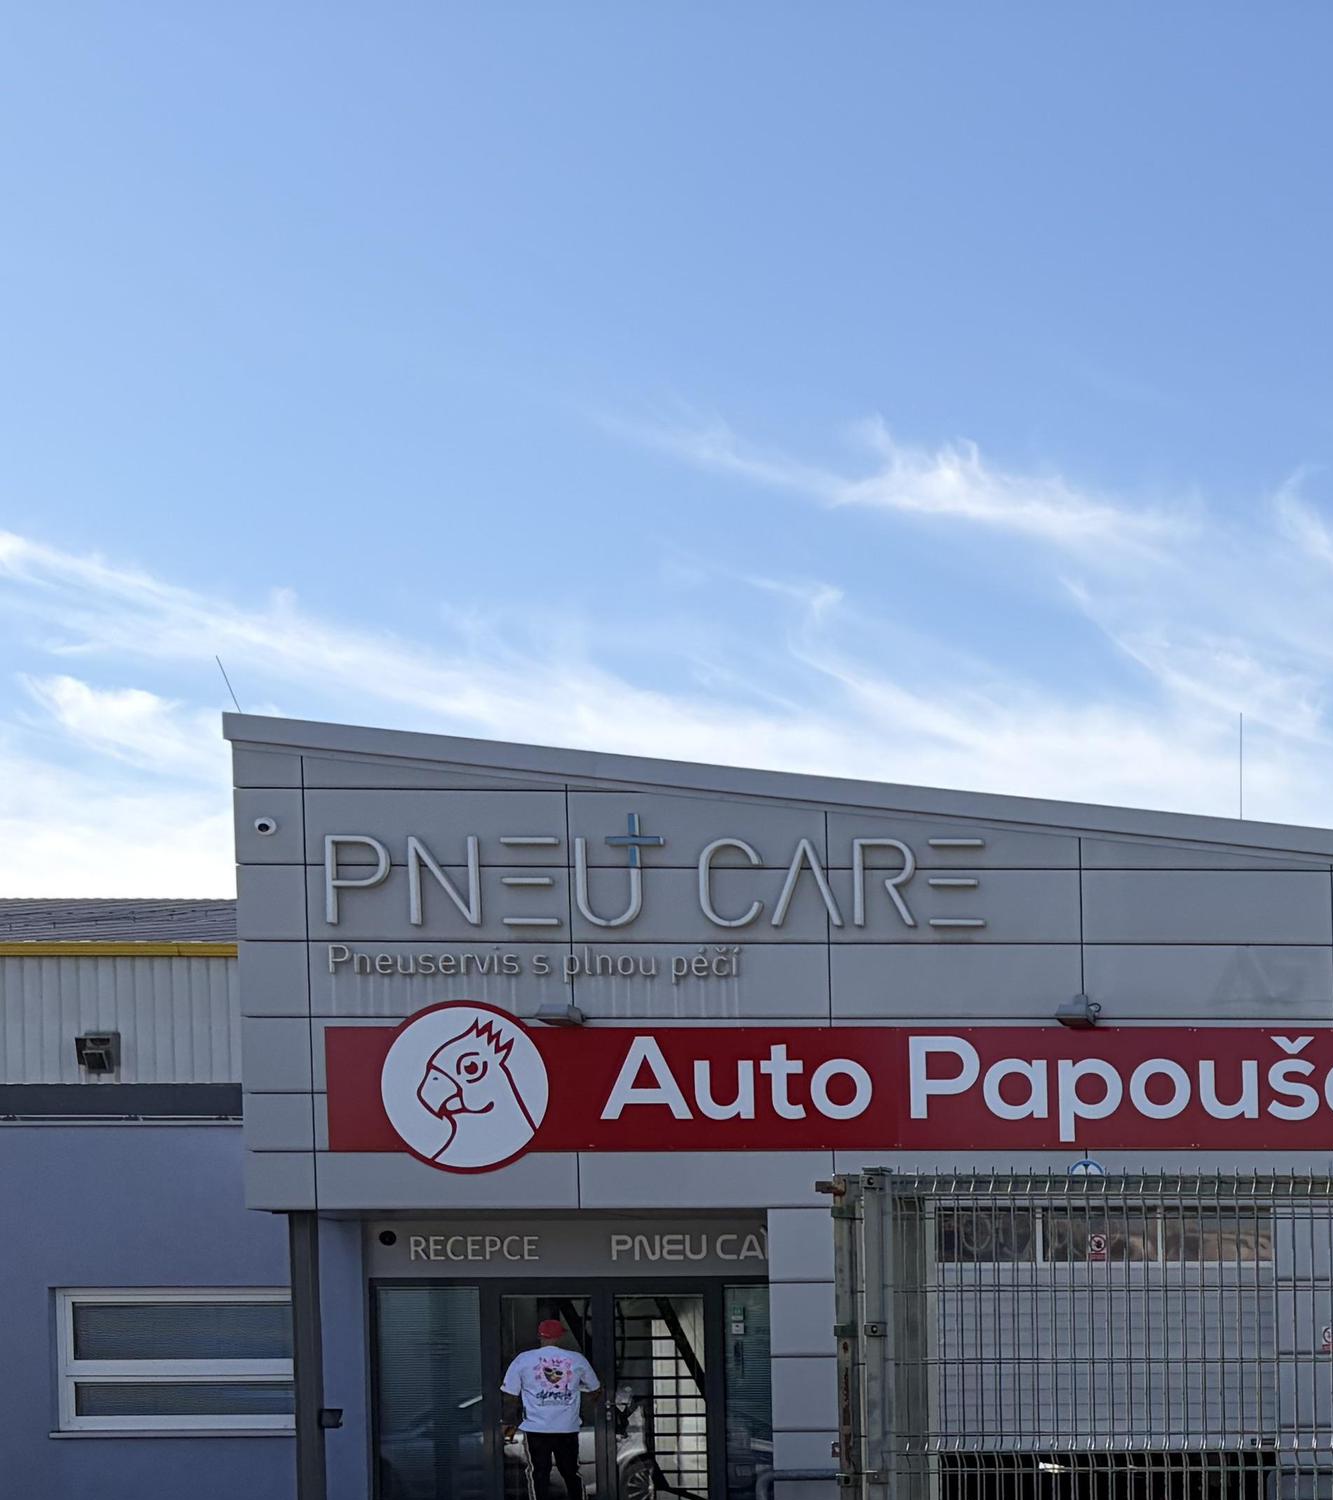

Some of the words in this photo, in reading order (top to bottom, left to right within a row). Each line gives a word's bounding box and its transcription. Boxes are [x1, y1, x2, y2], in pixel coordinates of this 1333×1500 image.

[324, 813, 664, 927] PNEU
[697, 837, 986, 928] CARE
[327, 944, 520, 976] Pneuservis
[531, 953, 550, 976] s
[562, 946, 658, 985] plnou
[671, 946, 742, 985] péčí
[600, 1035, 874, 1121] Auto
[409, 1234, 540, 1261] RECEPCE
[610, 1234, 707, 1261] PNEU
[716, 1233, 769, 1261] CA
